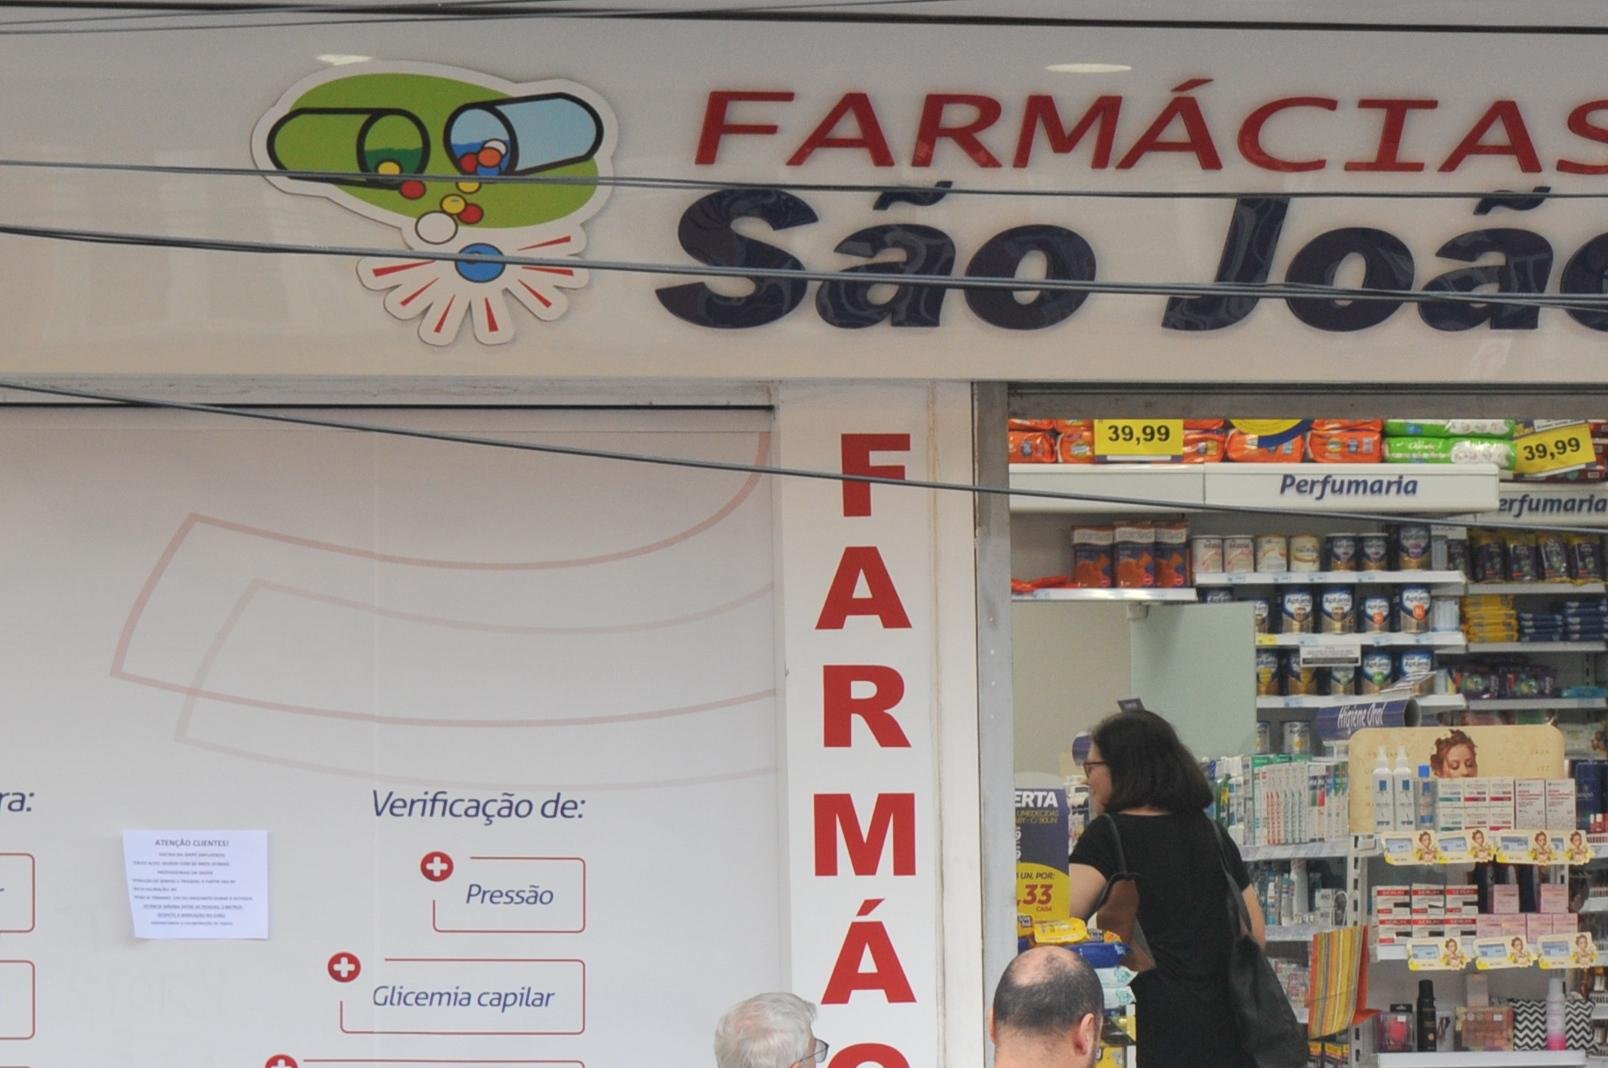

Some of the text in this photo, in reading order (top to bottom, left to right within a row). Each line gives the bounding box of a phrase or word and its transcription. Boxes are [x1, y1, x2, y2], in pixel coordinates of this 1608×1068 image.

[654, 181, 1096, 331] São
[1107, 424, 1171, 446] 39,99
[1523, 437, 1581, 461] 39,99
[1280, 474, 1418, 500] Perfumaria
[1499, 493, 1608, 518] erfumaria
[1337, 704, 1385, 731] Higiene Oral
[371, 789, 586, 826] Verificação de:
[155, 838, 191, 848] ATENÇÃO
[466, 883, 555, 906] Pressão
[371, 985, 556, 1014] Glicemia capilar
